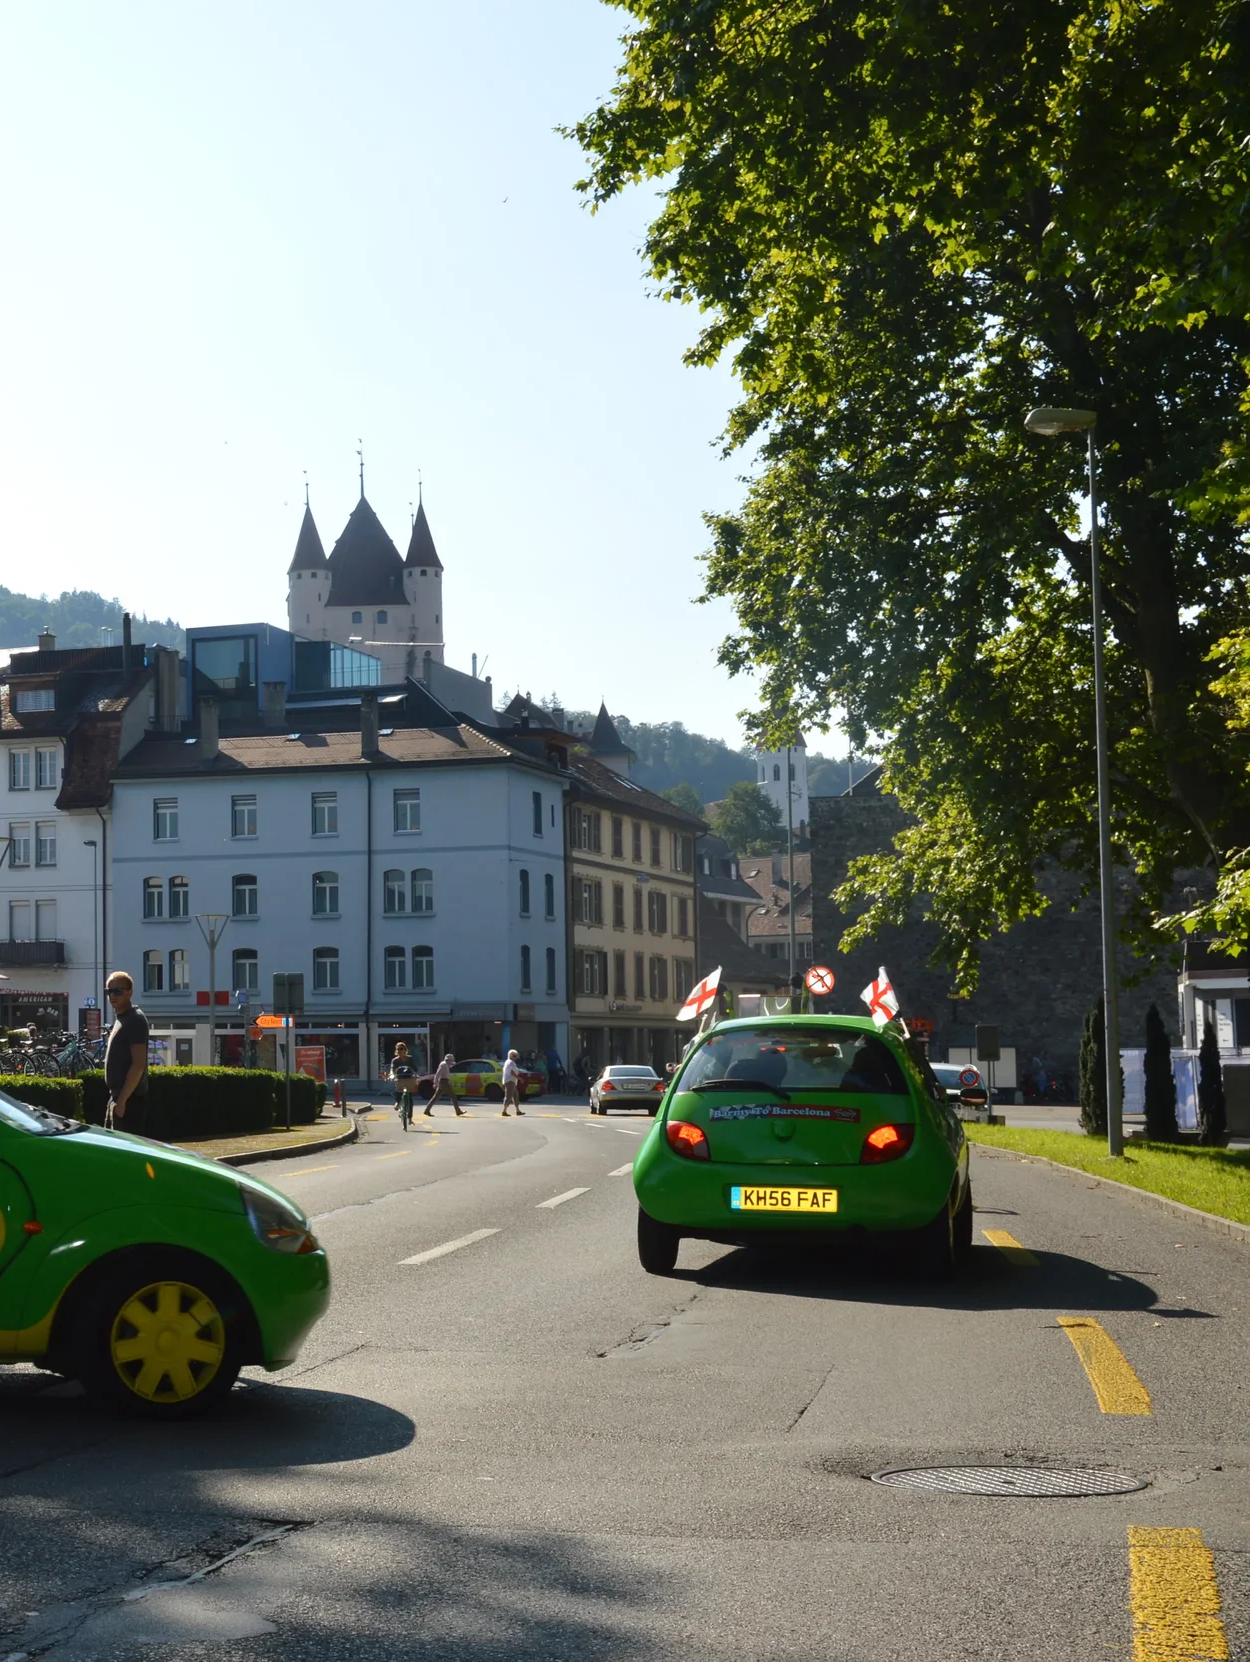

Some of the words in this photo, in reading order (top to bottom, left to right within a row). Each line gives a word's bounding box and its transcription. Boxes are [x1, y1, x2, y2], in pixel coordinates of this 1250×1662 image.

[46, 1006, 59, 1017] BAR
[713, 1108, 750, 1119] Barmy
[754, 1107, 769, 1116] To
[772, 1107, 830, 1117] Barcelona
[744, 1190, 791, 1207] KH56
[797, 1191, 833, 1208] FAF
